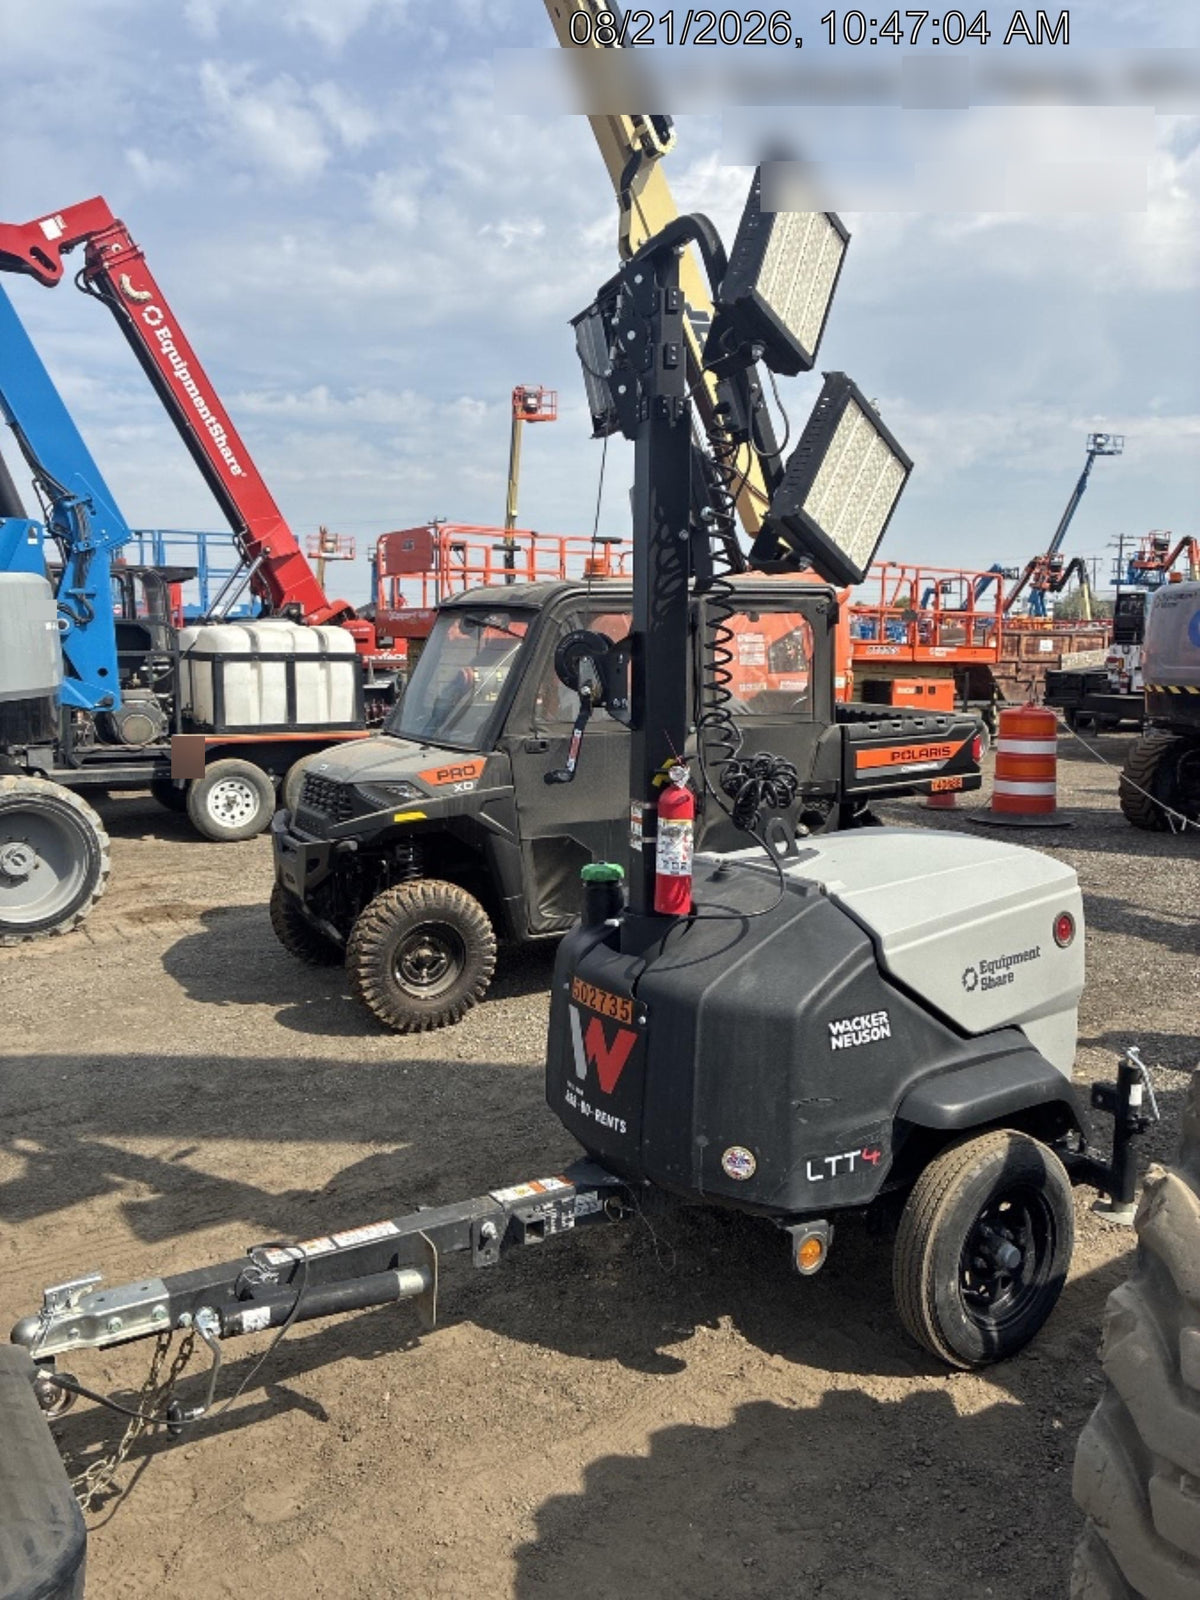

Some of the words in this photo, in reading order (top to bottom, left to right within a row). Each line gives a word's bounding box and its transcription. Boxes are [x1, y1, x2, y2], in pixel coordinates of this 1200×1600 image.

[155, 326, 243, 476] EquipmentShare
[891, 746, 951, 761] POLARIS
[437, 764, 476, 781] PRO
[454, 781, 474, 792] XD
[979, 945, 1041, 974] Equipment
[980, 972, 1014, 991] Share
[572, 979, 630, 1021] 502735
[828, 1011, 889, 1035] WACKER
[831, 1023, 892, 1050] NEUSON
[806, 1147, 881, 1182] LTT4
